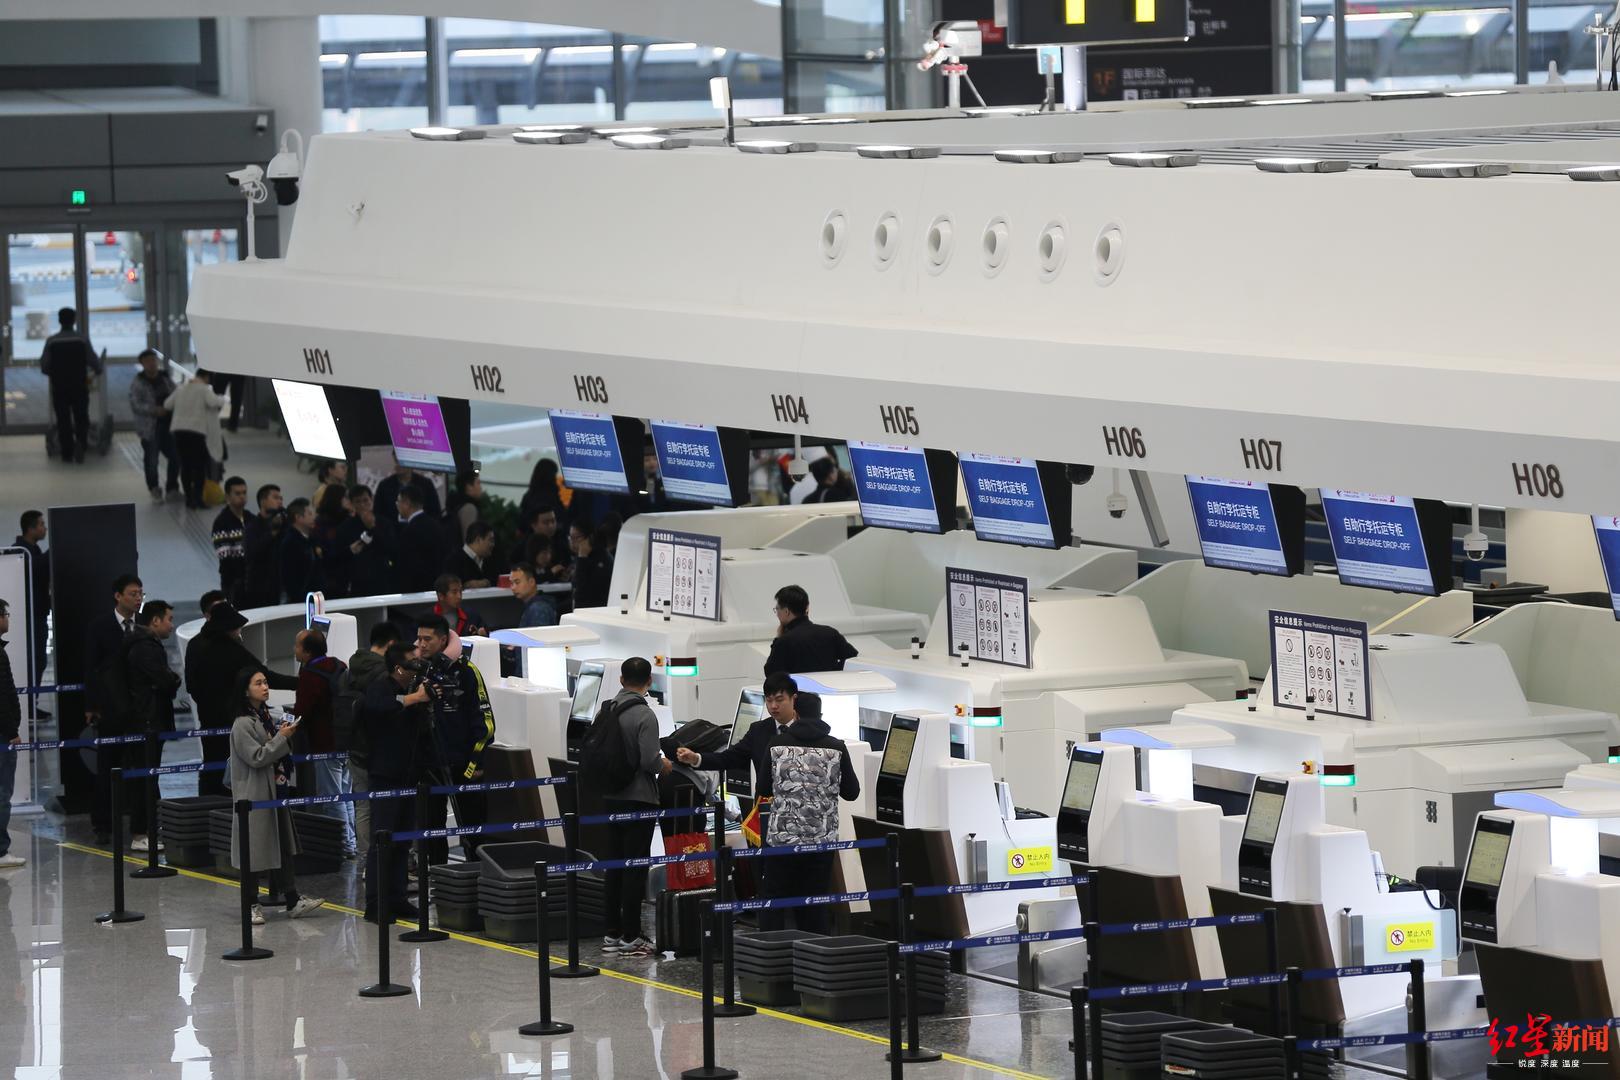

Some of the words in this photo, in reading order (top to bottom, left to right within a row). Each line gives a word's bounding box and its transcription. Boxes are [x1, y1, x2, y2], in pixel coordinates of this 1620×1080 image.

[304, 348, 334, 375] H01
[470, 364, 505, 393] H02
[574, 374, 609, 404] H03
[771, 394, 809, 424] H04
[880, 405, 920, 436] H05
[667, 441, 710, 457] 自助行李托运专柜
[1102, 425, 1146, 459] H06
[1240, 438, 1282, 472] H07
[866, 465, 916, 481] 自助行李托运专柜
[1512, 462, 1564, 499] H08
[866, 481, 877, 489] SELF
[877, 482, 898, 492] BAGGAGE
[978, 478, 1029, 495] 自助行李托运专柜
[978, 495, 989, 503] SELF
[990, 496, 1011, 506] BAGGAGE
[1207, 500, 1260, 519] 自助行李托运专柜
[1207, 518, 1219, 528] SELF
[1219, 520, 1241, 530] BAGGAGE
[1343, 517, 1404, 537] 自助行李托运专柜
[1343, 535, 1356, 545] SELF
[1357, 537, 1383, 548] BAGGAGE
[1274, 615, 1304, 628] 安全信息提示
[1407, 929, 1432, 937] 禁止入内
